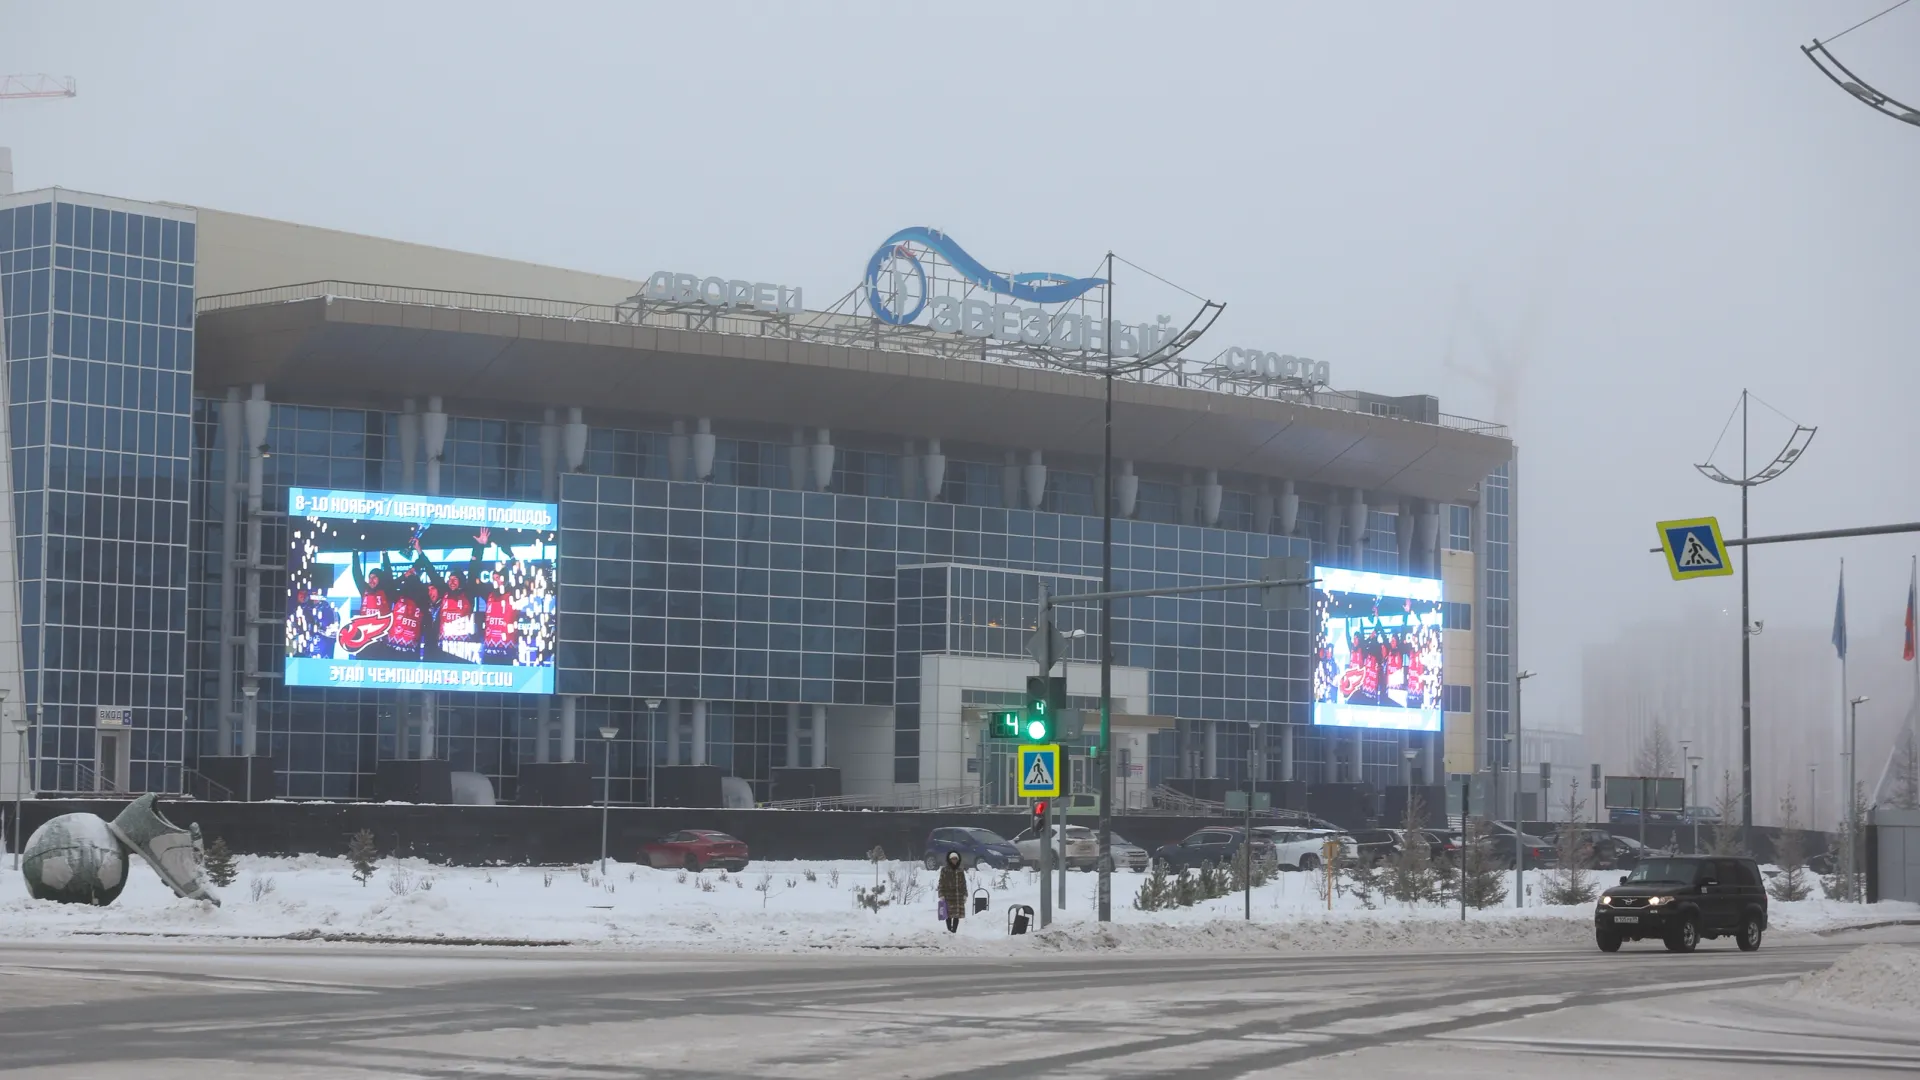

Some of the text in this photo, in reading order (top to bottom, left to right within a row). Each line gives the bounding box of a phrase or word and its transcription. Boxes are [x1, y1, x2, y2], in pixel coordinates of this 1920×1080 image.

[650, 271, 803, 314] ДВОРЕЦ
[929, 295, 1179, 359] ЗВЕЗДНЫЙ
[1226, 346, 1330, 385] СПОРТА
[295, 495, 328, 512] 8-10
[331, 497, 385, 515] НОЯБРЯ
[394, 501, 486, 521] ЦЕНТРАЛЬНАЯ
[488, 507, 552, 526] ПЛОЩАДЬ
[329, 665, 513, 687] ЭТАП ЧЕМПИОНАТА РОССИИ
[100, 710, 122, 719] ВХОД
[1036, 702, 1044, 715] 4
[1006, 713, 1019, 736] 4
